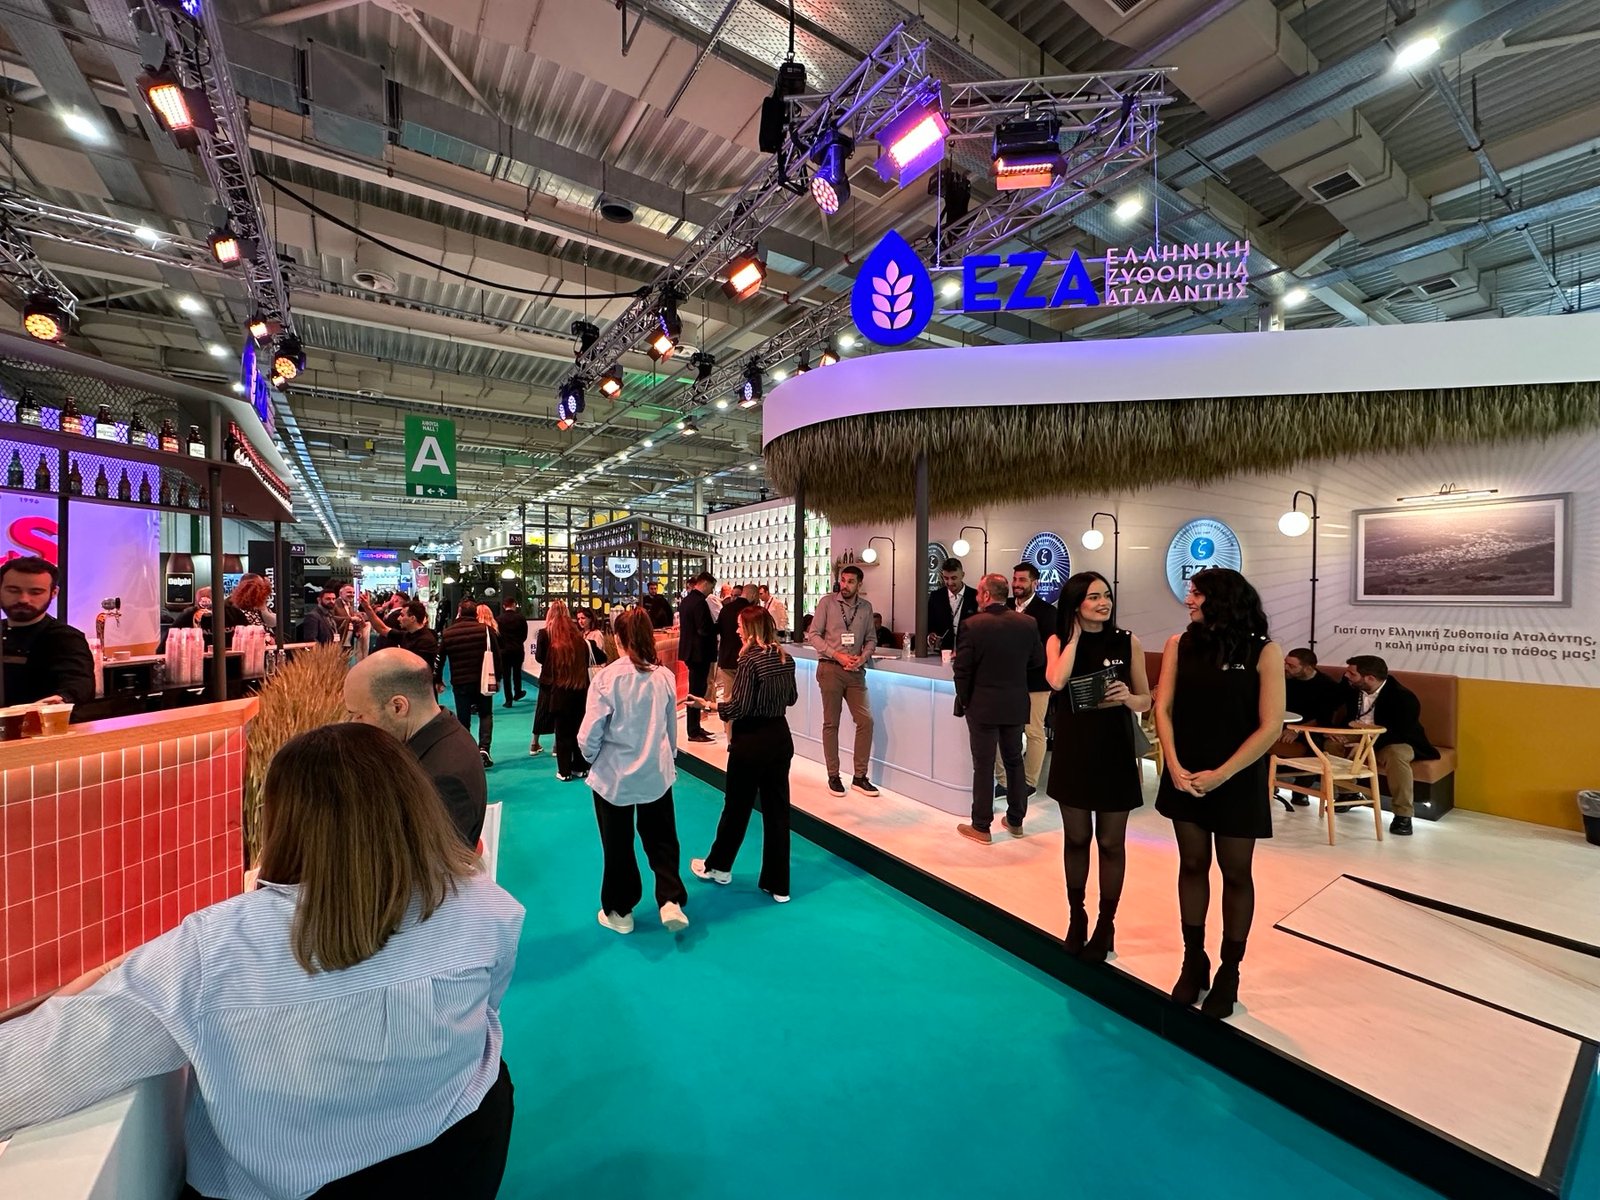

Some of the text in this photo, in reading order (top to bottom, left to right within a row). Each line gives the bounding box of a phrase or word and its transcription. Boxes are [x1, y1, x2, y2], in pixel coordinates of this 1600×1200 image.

[1107, 240, 1250, 264] ΕΛΛΗΝΙΚΗ
[963, 250, 1100, 313] EZA
[1105, 282, 1249, 306] ΑΤΑΛΑΝΤΗΣ
[411, 435, 451, 475] A
[167, 577, 191, 587] Delphi
[1333, 625, 1358, 634] Γιατί
[1360, 627, 1385, 637] στην
[1388, 626, 1440, 639] Ελληνική
[1513, 631, 1597, 646] Αταλάντης,
[1375, 640, 1596, 661] η καλή μπύρα είναι το πάθος μας!
